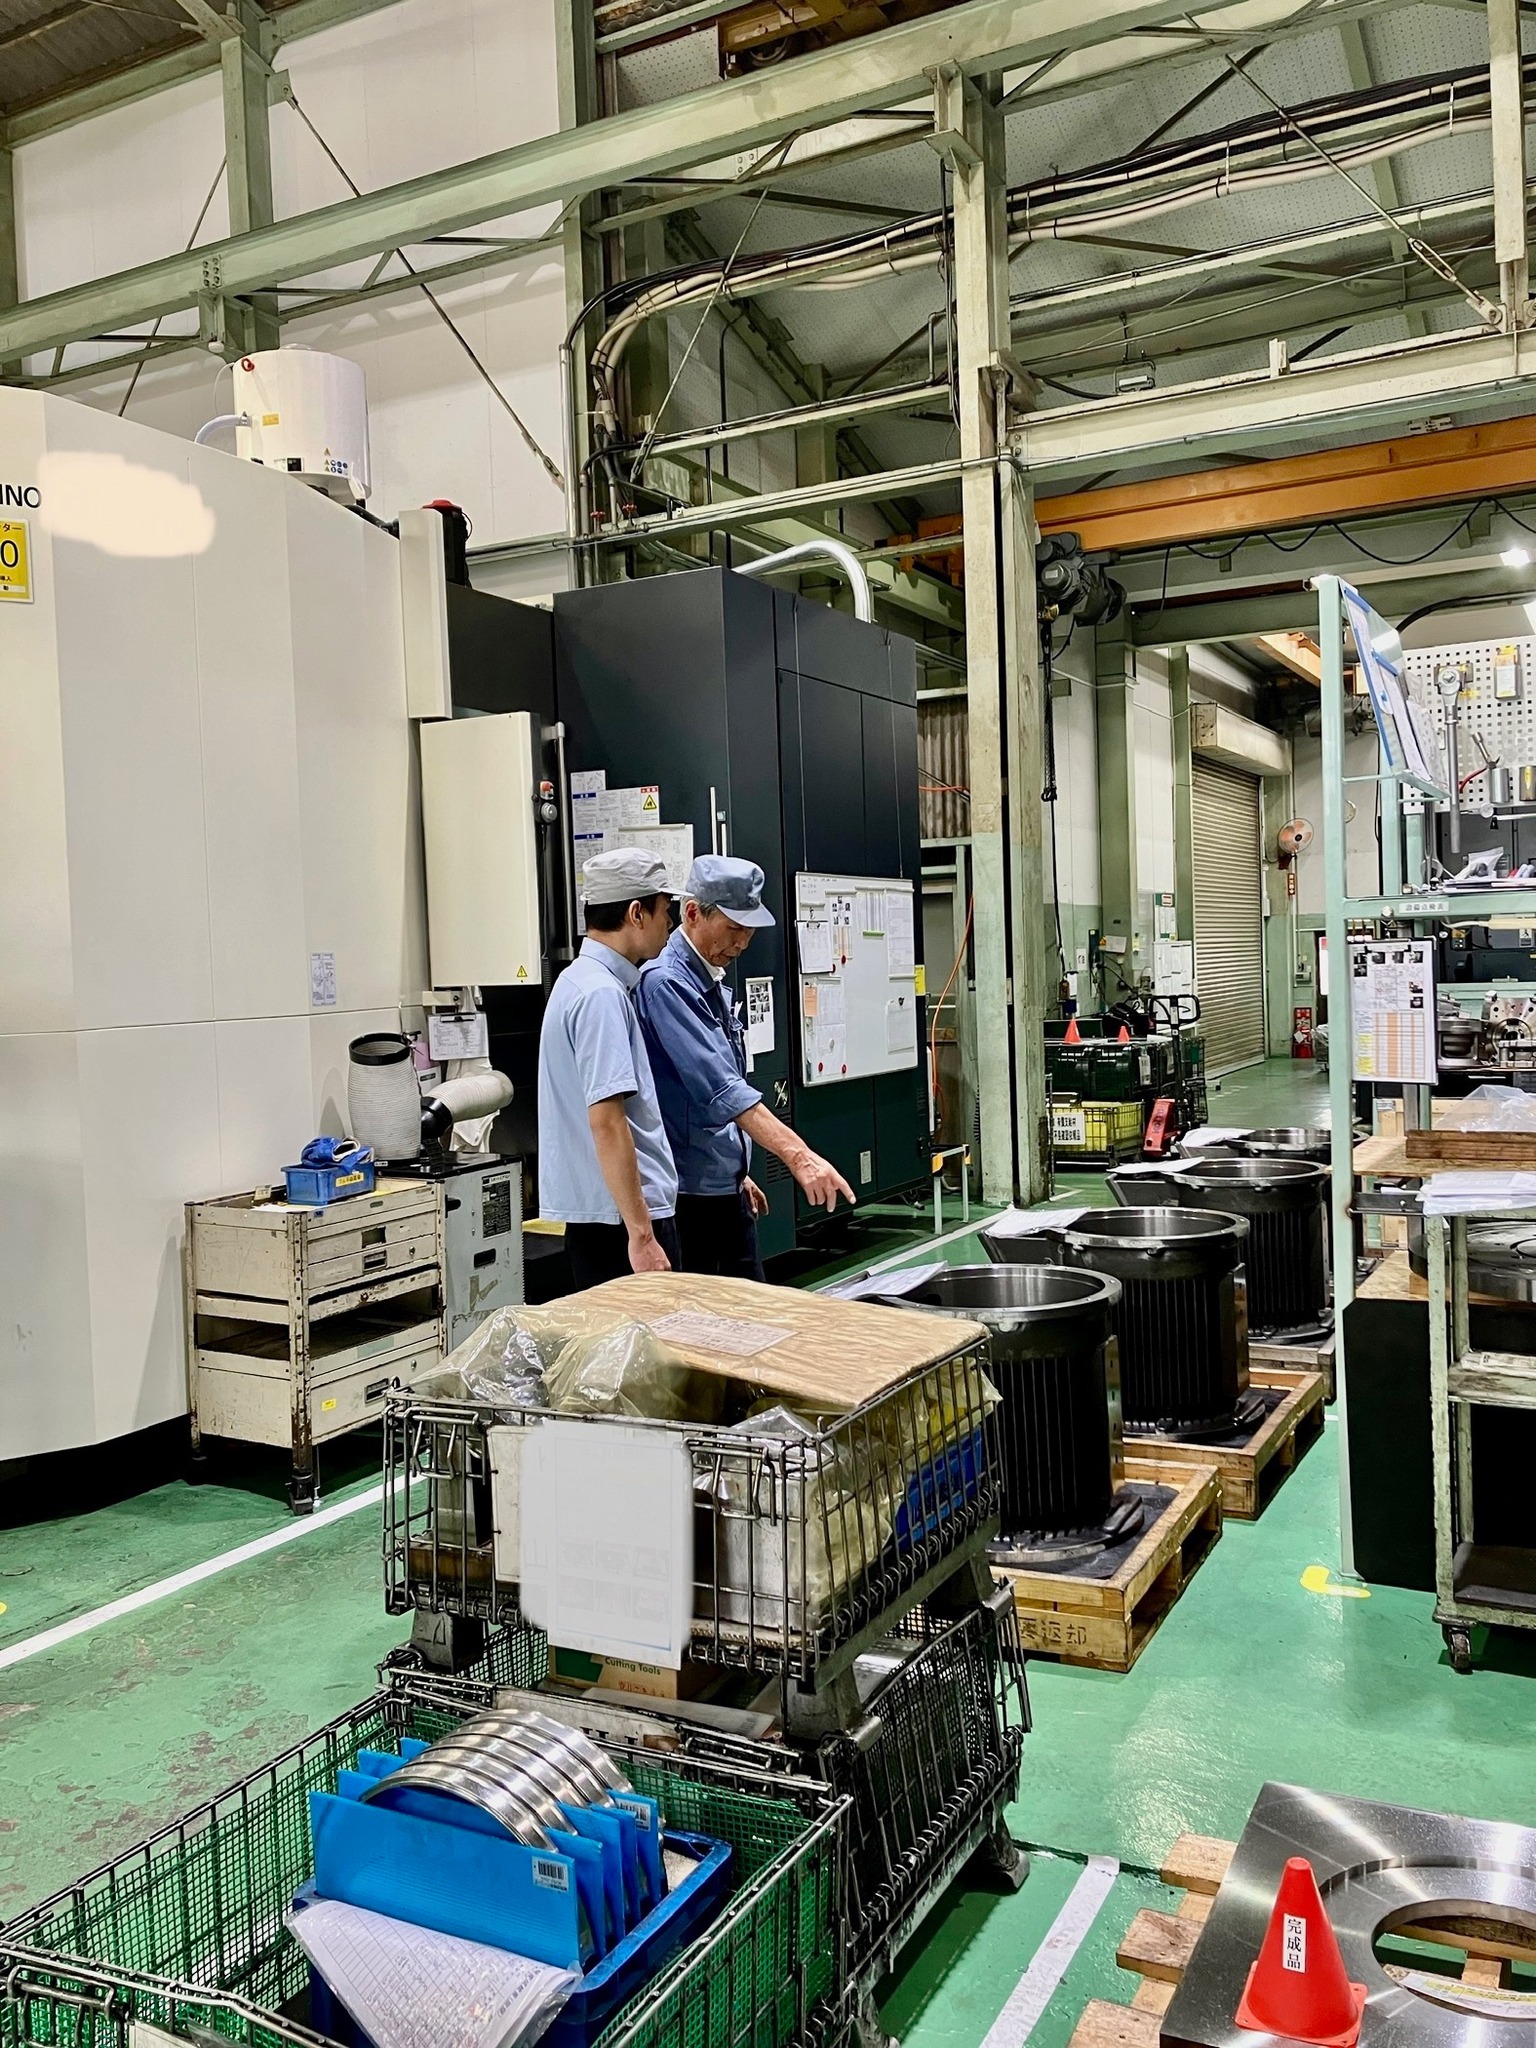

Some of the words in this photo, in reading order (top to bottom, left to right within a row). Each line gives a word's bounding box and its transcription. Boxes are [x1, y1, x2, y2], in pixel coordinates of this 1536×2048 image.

[0, 523, 22, 532] ター
[605, 1657, 636, 1672] Cutting
[638, 1663, 661, 1675] Tools
[1287, 1918, 1302, 1969] 完成品
